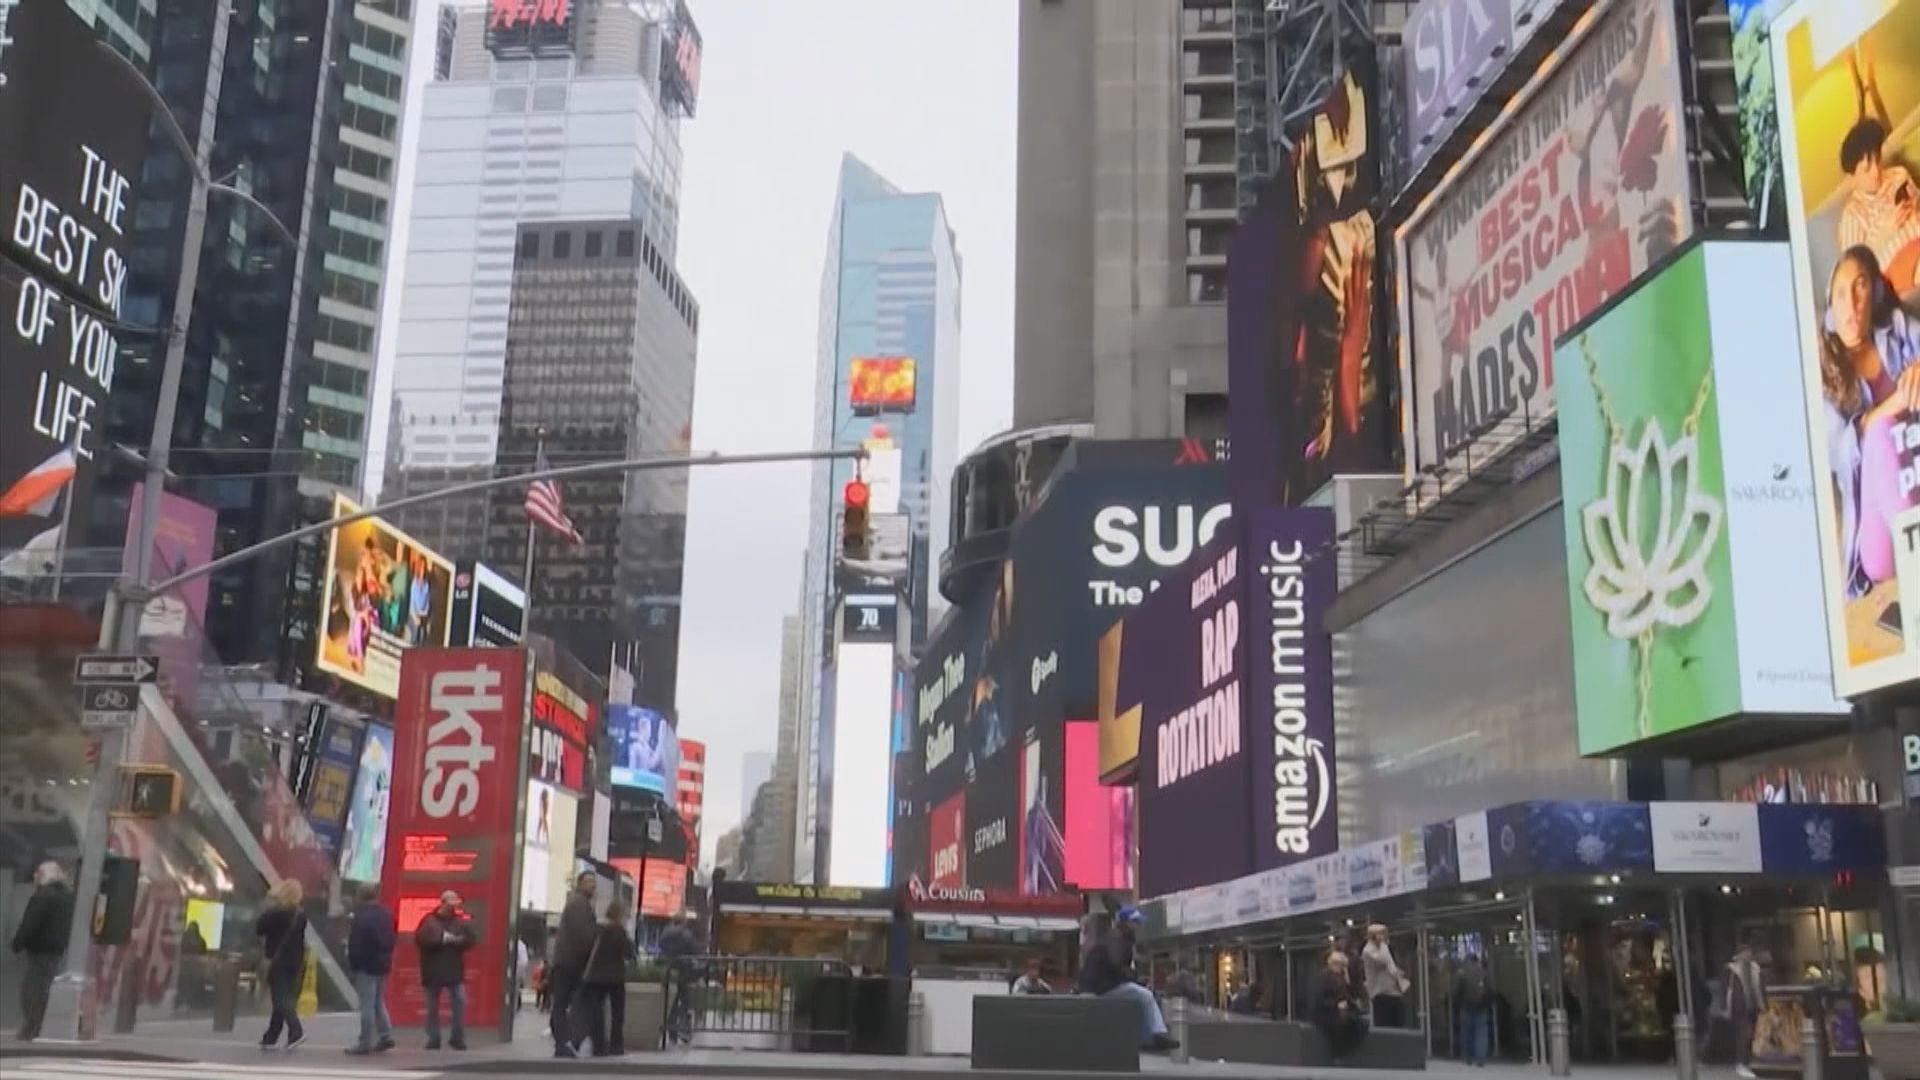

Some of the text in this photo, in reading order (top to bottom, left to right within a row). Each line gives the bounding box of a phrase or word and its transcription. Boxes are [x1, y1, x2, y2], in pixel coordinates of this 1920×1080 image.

[1424, 133, 1519, 260] WINNER!
[1534, 88, 1570, 150] TONY
[1575, 11, 1638, 110] AWARDS
[13, 183, 98, 286] BEST
[81, 144, 131, 235] THE
[1478, 136, 1564, 267] BEST
[1449, 170, 1605, 352] MUSICAL
[16, 276, 61, 347] OF
[33, 370, 97, 461] LIFE
[455, 589, 469, 599] LG
[860, 608, 878, 626] 70
[1088, 580, 1144, 606] The
[1201, 599, 1239, 688] RAP
[421, 663, 503, 818] tkts
[1157, 679, 1240, 789] ROTATION
[1259, 539, 1312, 854] amazon music
[974, 816, 1007, 855] SEPHORA
[927, 880, 985, 903] Cousins
